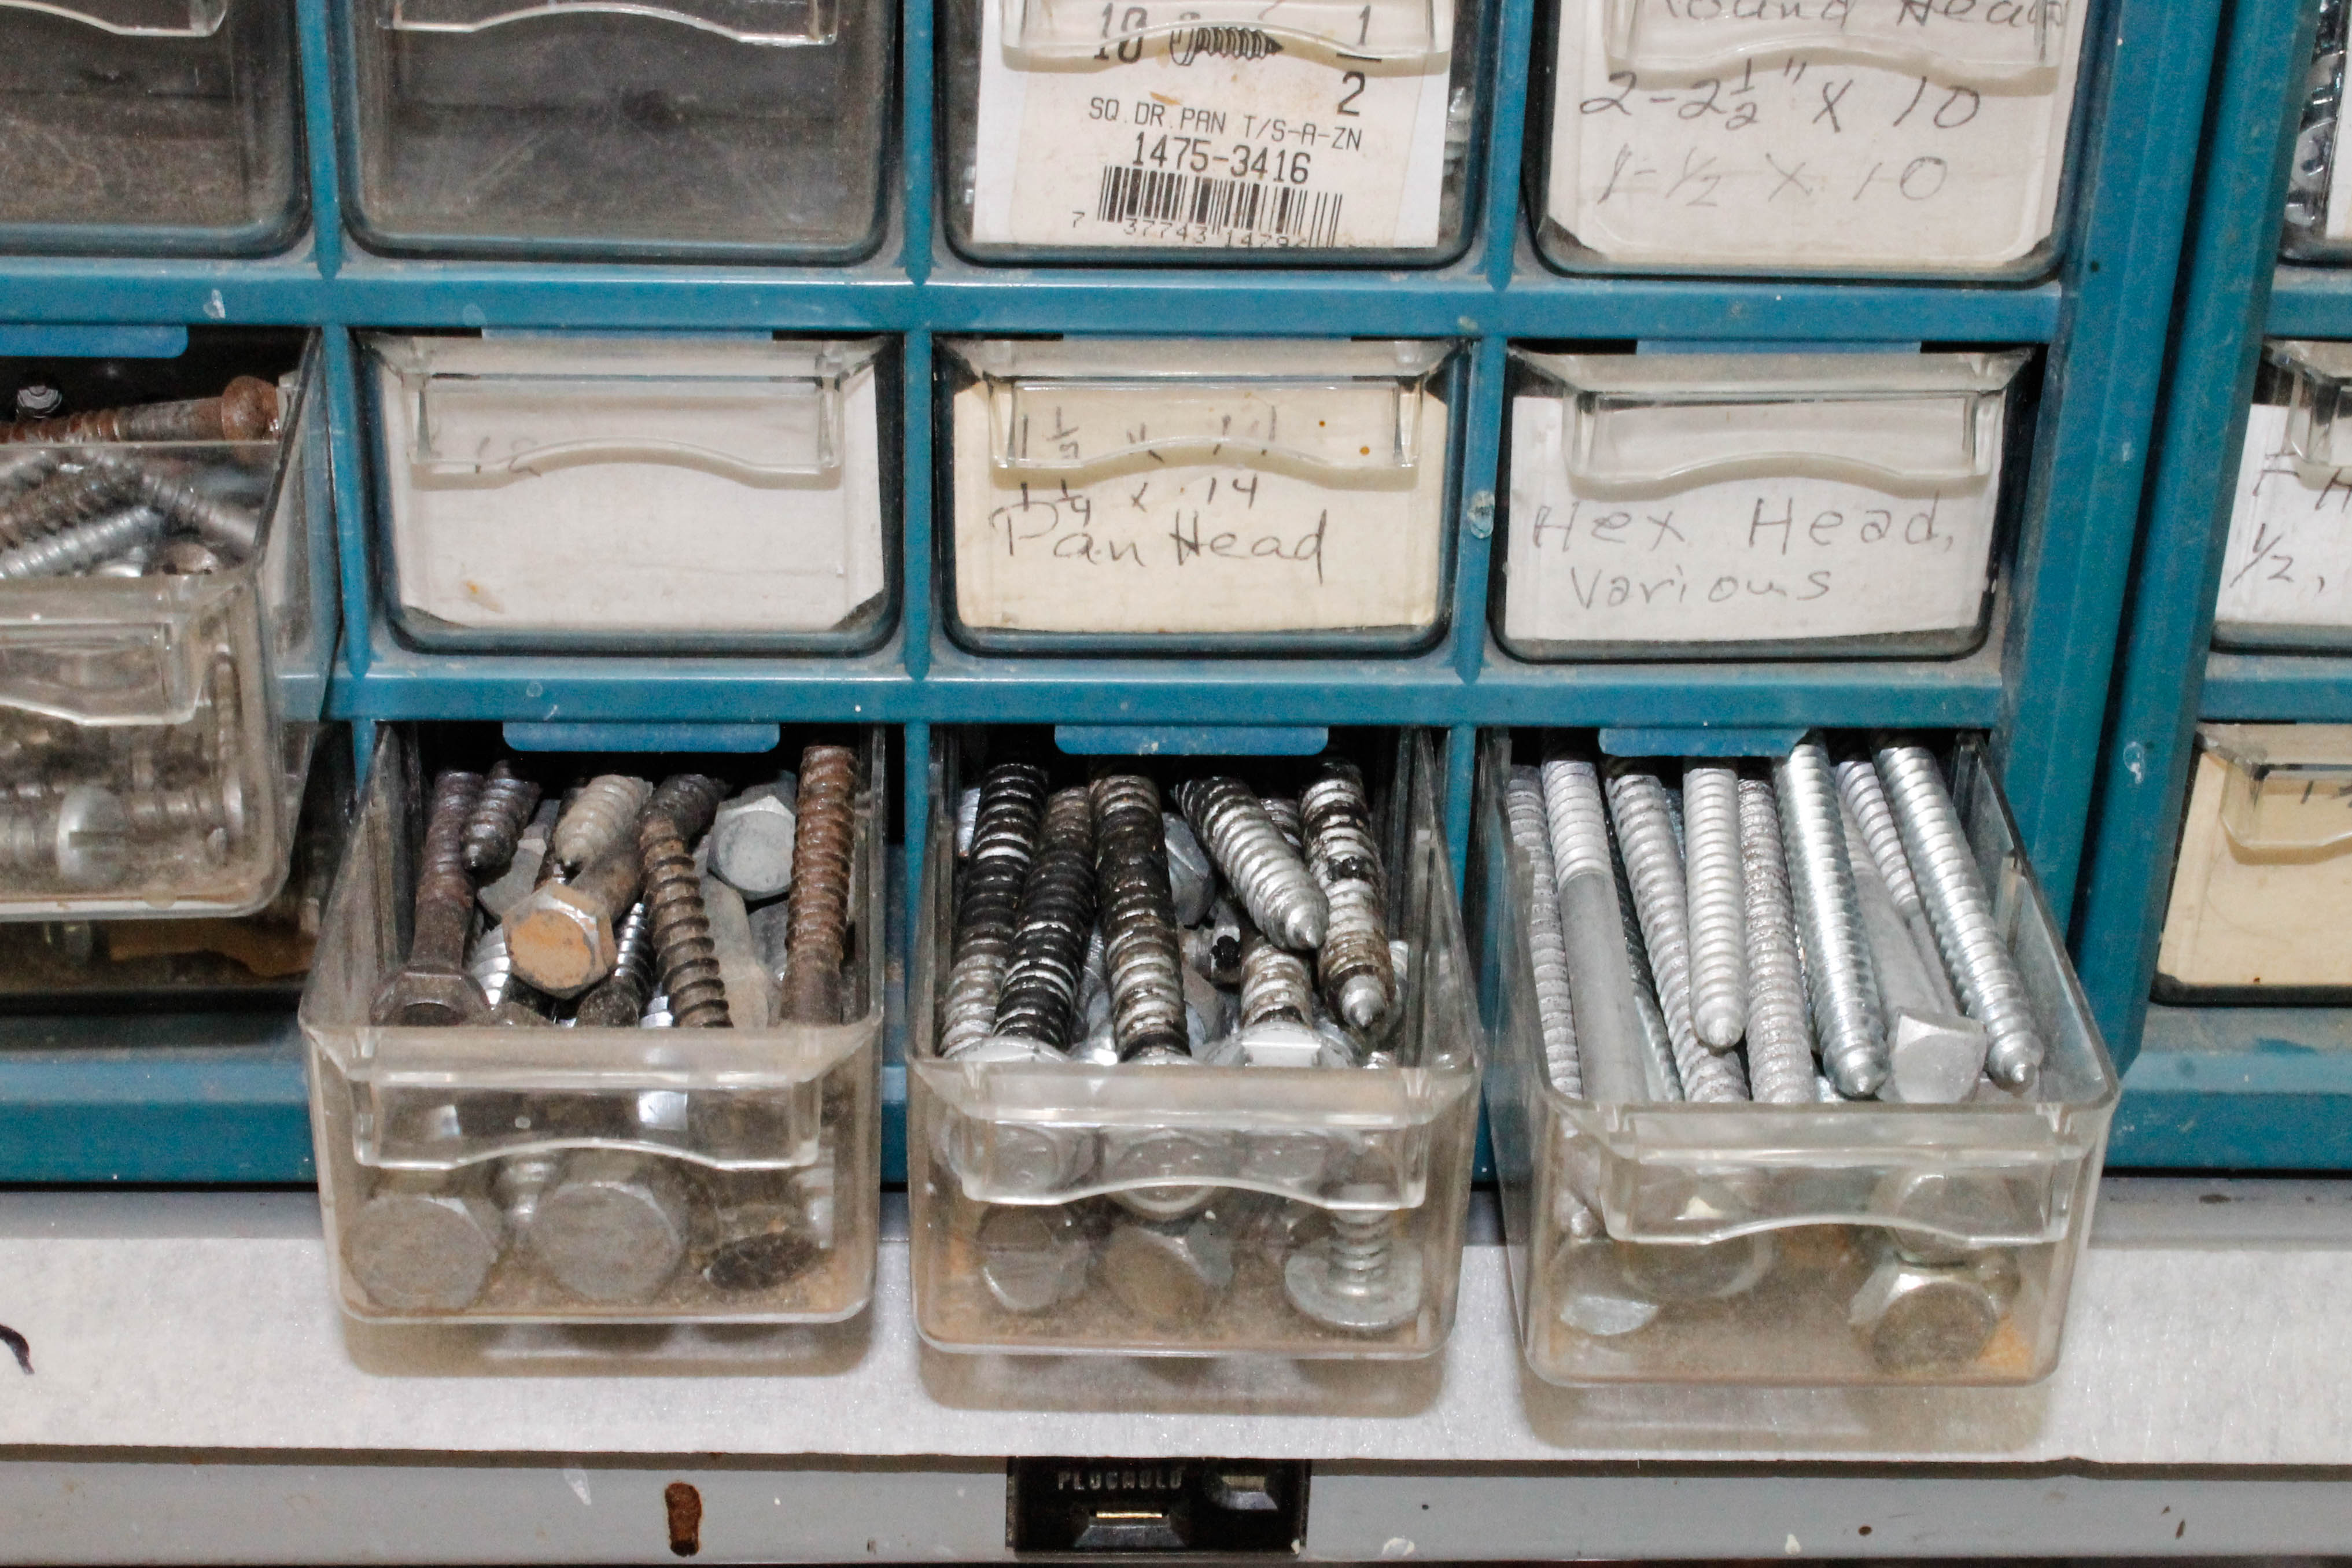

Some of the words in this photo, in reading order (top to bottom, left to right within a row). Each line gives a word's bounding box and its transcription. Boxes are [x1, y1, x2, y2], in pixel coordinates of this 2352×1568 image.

[1893, 76, 1982, 129] 10
[1132, 131, 1311, 183] 1475-3416
[1072, 211, 1085, 228] 7
[1123, 217, 1208, 244] 37743
[1207, 473, 1258, 510] 14
[987, 500, 1148, 567] Pan
[1169, 508, 1328, 585] Head
[1533, 500, 1687, 553] Hex
[1569, 565, 1833, 610] Various
